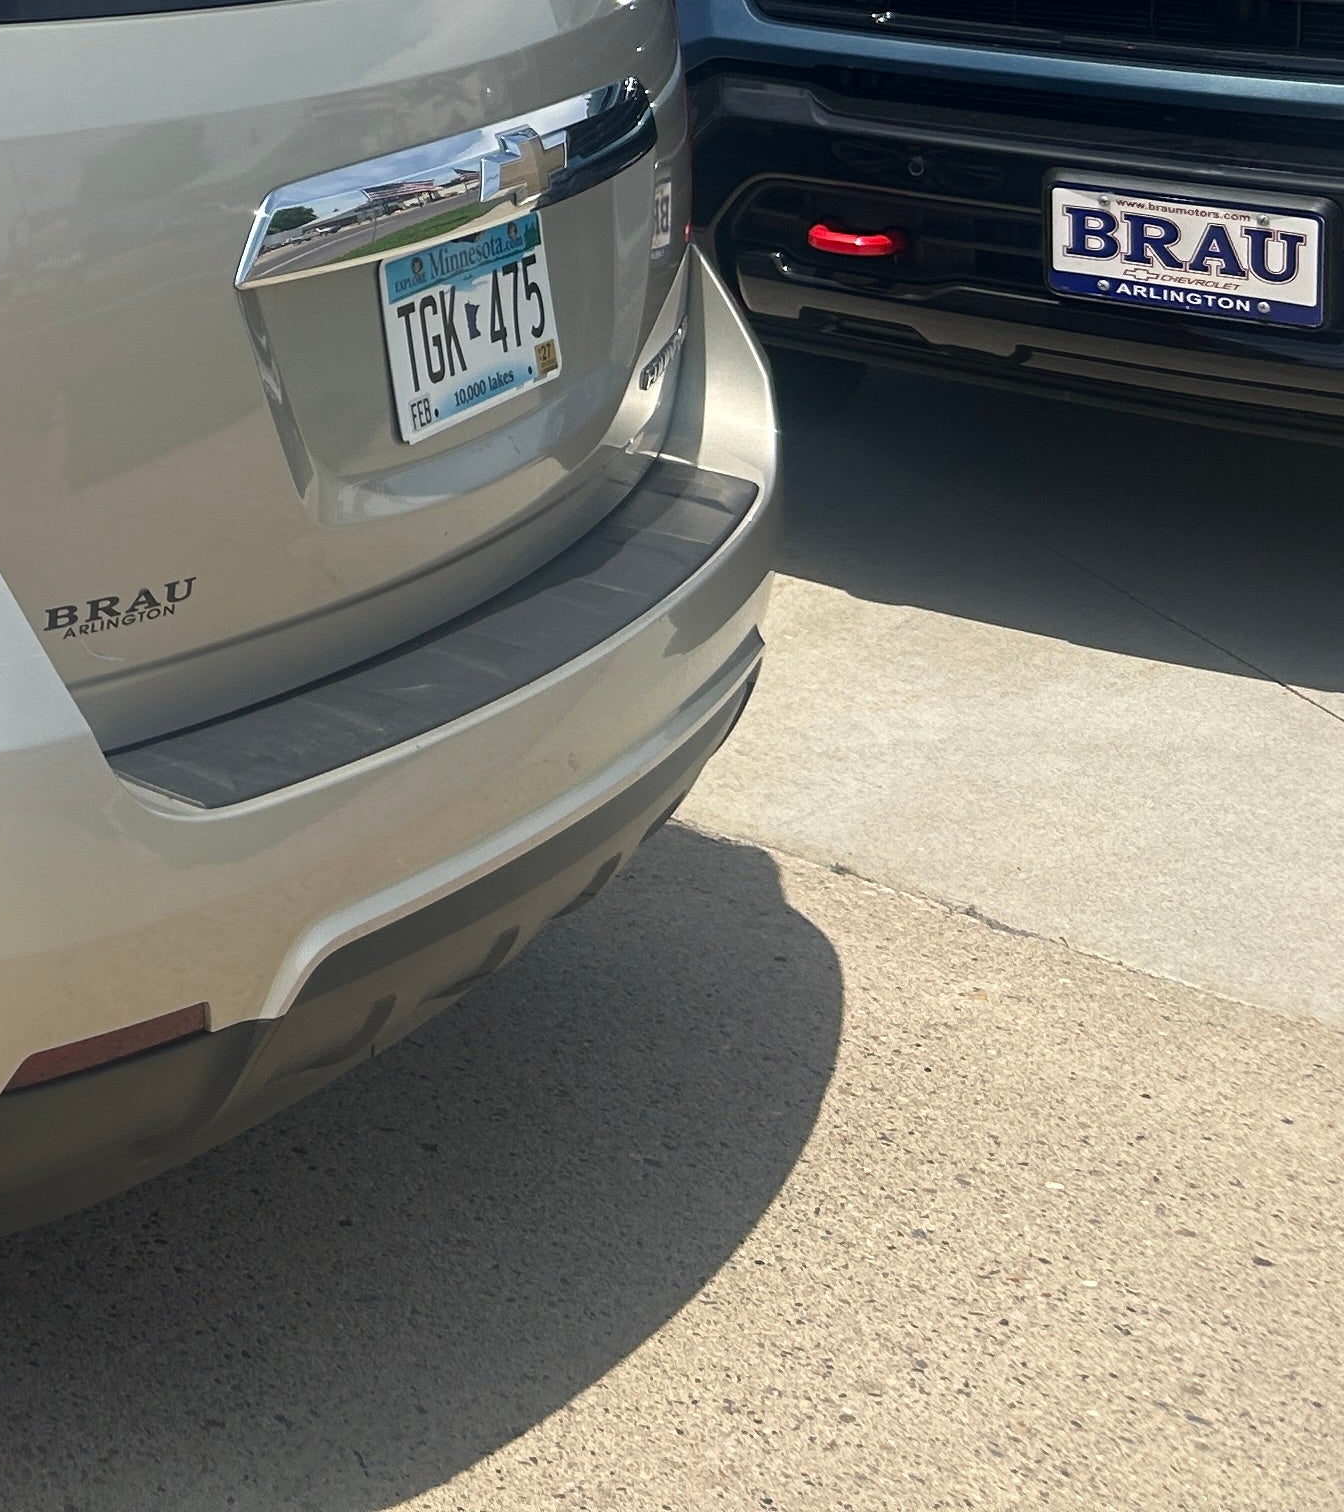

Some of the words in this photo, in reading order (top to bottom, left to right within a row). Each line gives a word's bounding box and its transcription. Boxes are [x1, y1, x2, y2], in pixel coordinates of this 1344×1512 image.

[1115, 197, 1252, 223] www.braumotors.com
[1062, 203, 1307, 286] BRAU
[1115, 283, 1252, 313] ARLINGTON
[1158, 274, 1242, 292] CHEVROLET
[397, 285, 468, 393] TGK
[490, 253, 546, 353] 475
[453, 378, 487, 407] 10,000
[487, 369, 515, 393] lakes
[411, 396, 432, 431] FEB
[43, 576, 197, 632] BRAU
[62, 603, 176, 639] ARLINGTON
